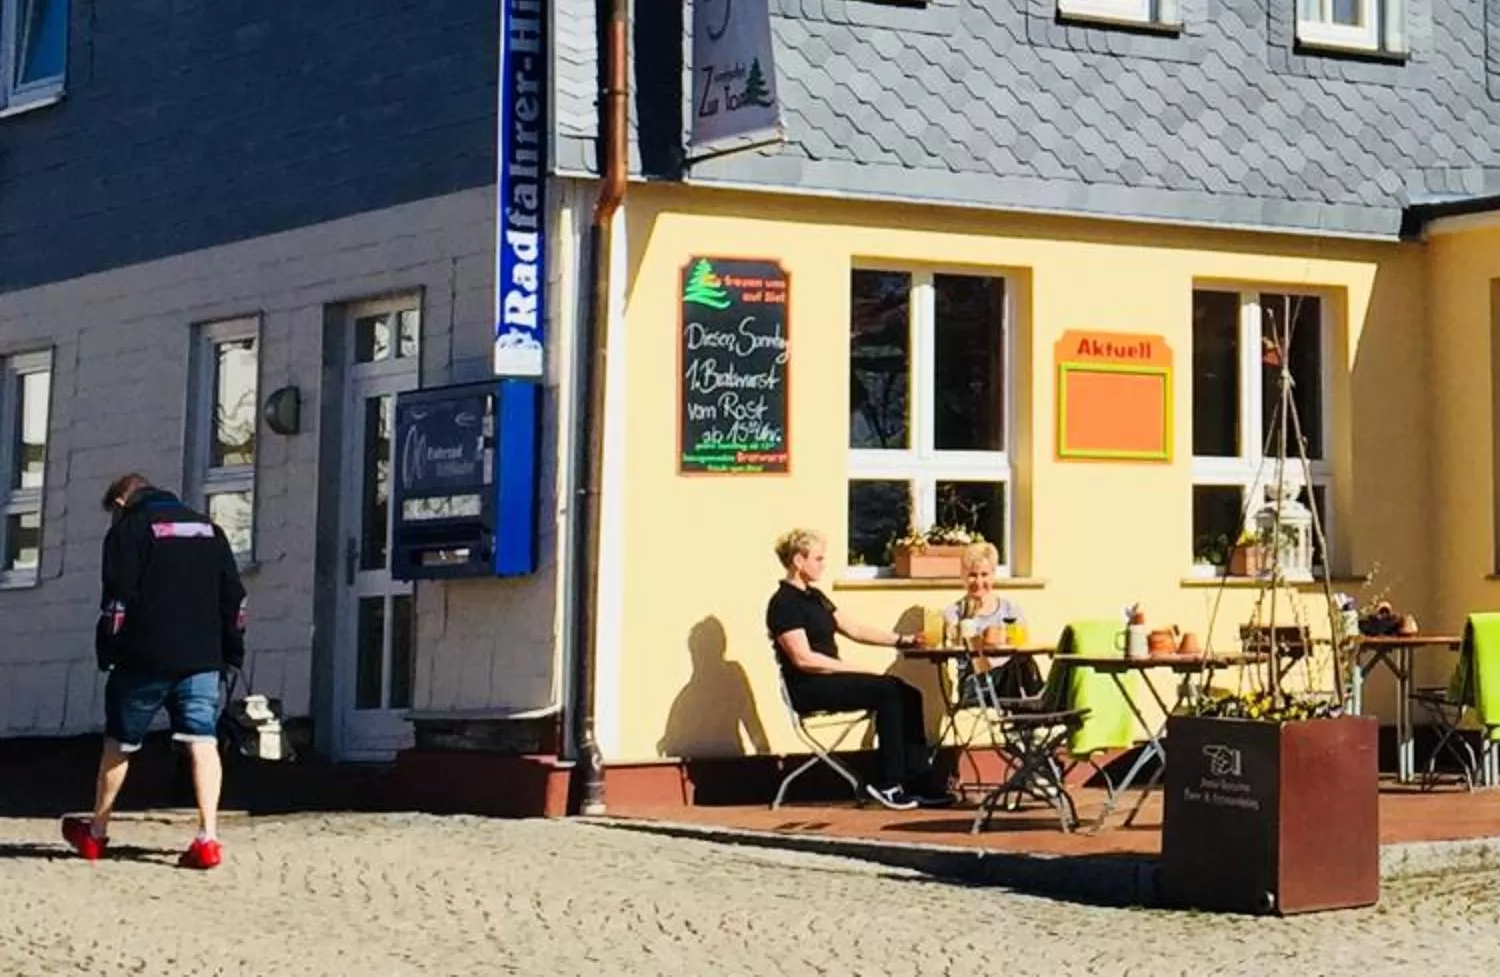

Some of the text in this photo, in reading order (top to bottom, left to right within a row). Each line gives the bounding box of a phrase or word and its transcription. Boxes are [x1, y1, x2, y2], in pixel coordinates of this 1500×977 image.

[684, 322, 736, 352] Diesen
[1077, 338, 1152, 360] Aktuell
[687, 391, 769, 423] vom Rost
[703, 424, 724, 444] ab
